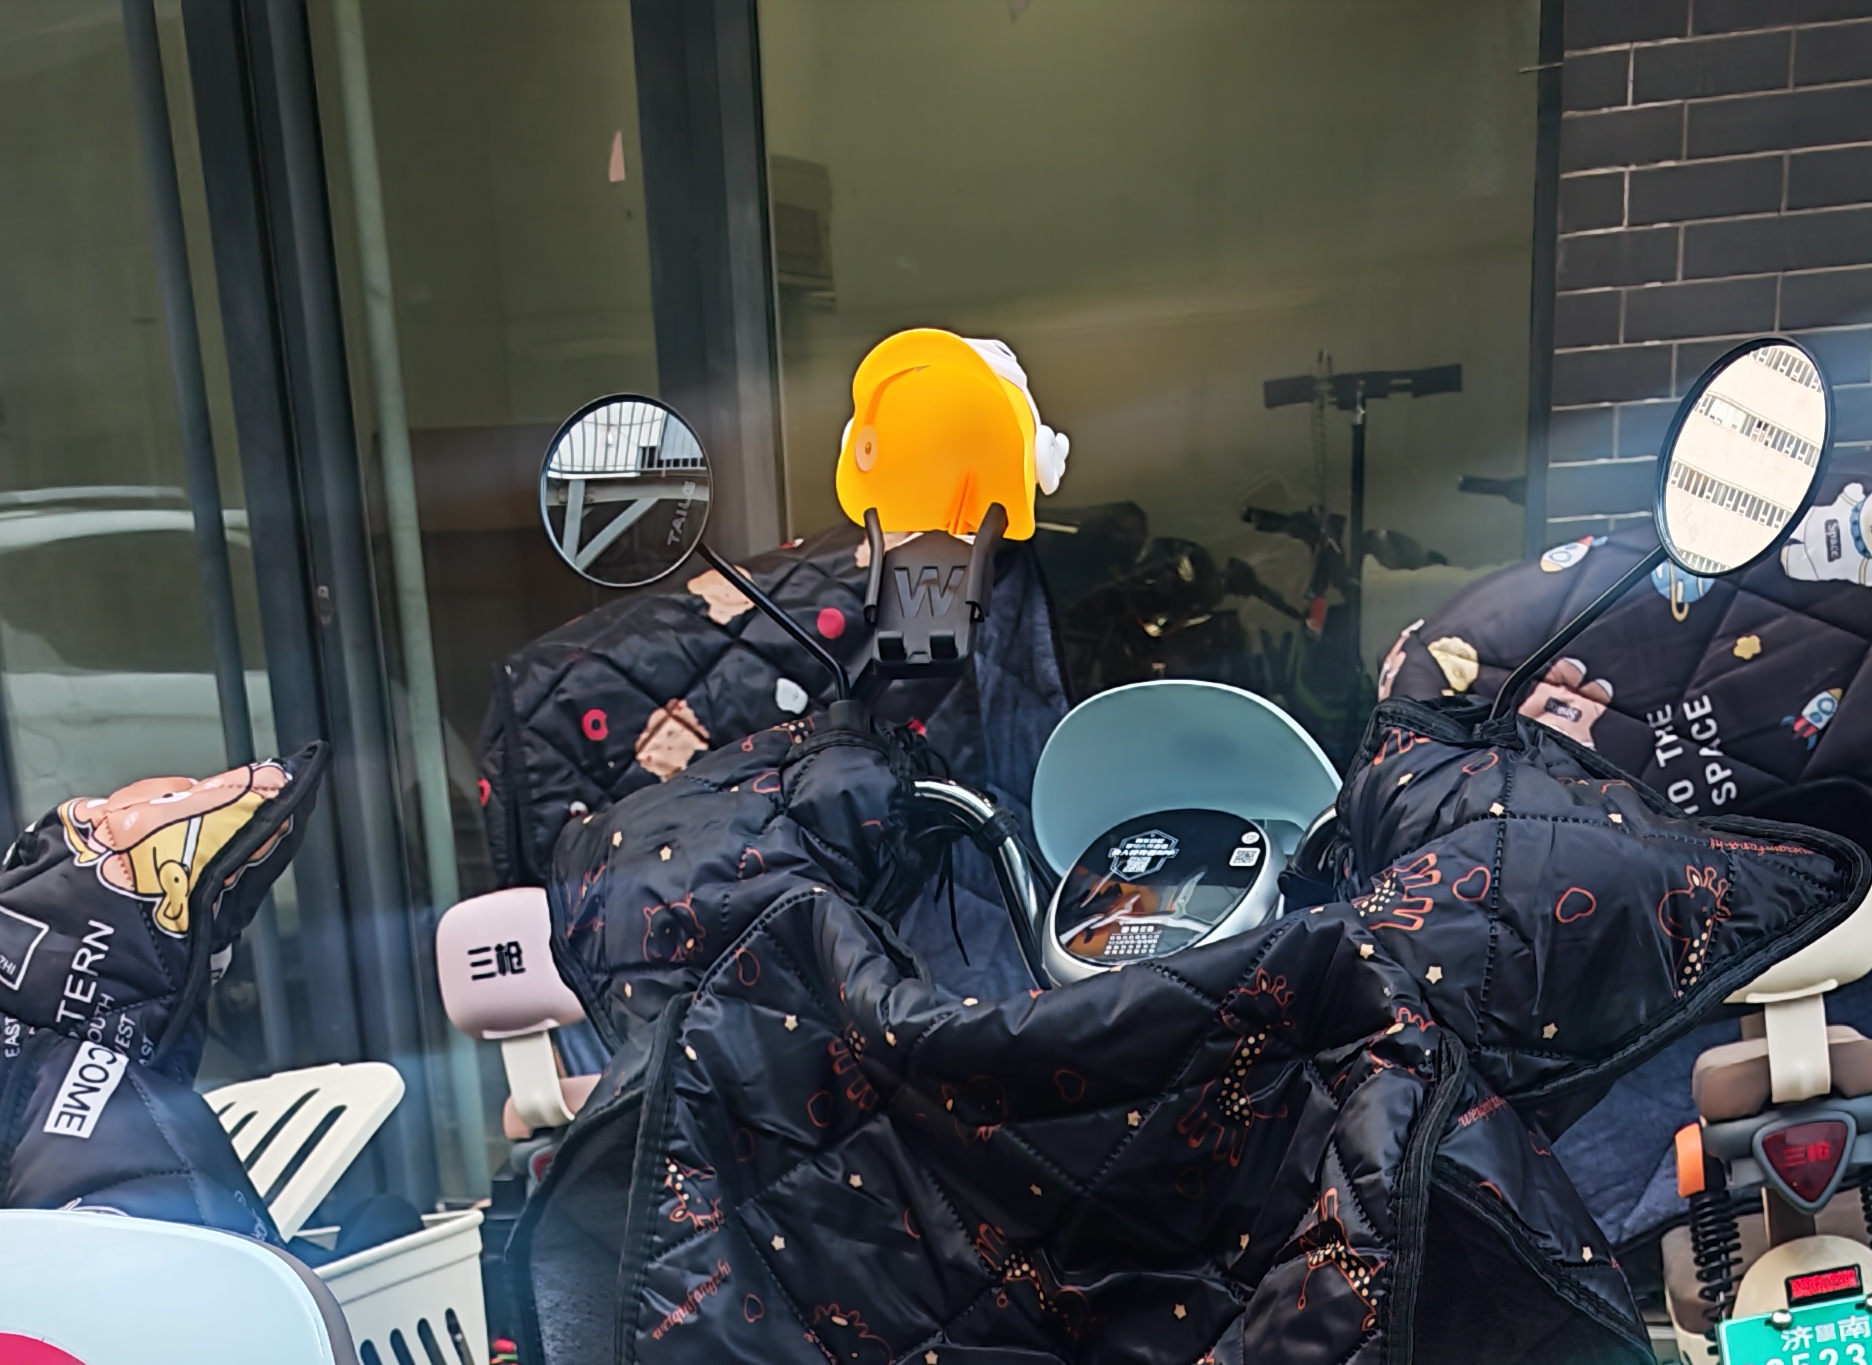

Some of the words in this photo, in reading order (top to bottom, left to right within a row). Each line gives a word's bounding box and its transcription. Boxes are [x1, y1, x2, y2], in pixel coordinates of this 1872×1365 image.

[1683, 694, 1738, 806] SPACE
[56, 919, 115, 1038] TERN
[87, 993, 115, 1046] OUTH
[4, 1016, 20, 1058] EAST
[53, 1046, 118, 1133] COME
